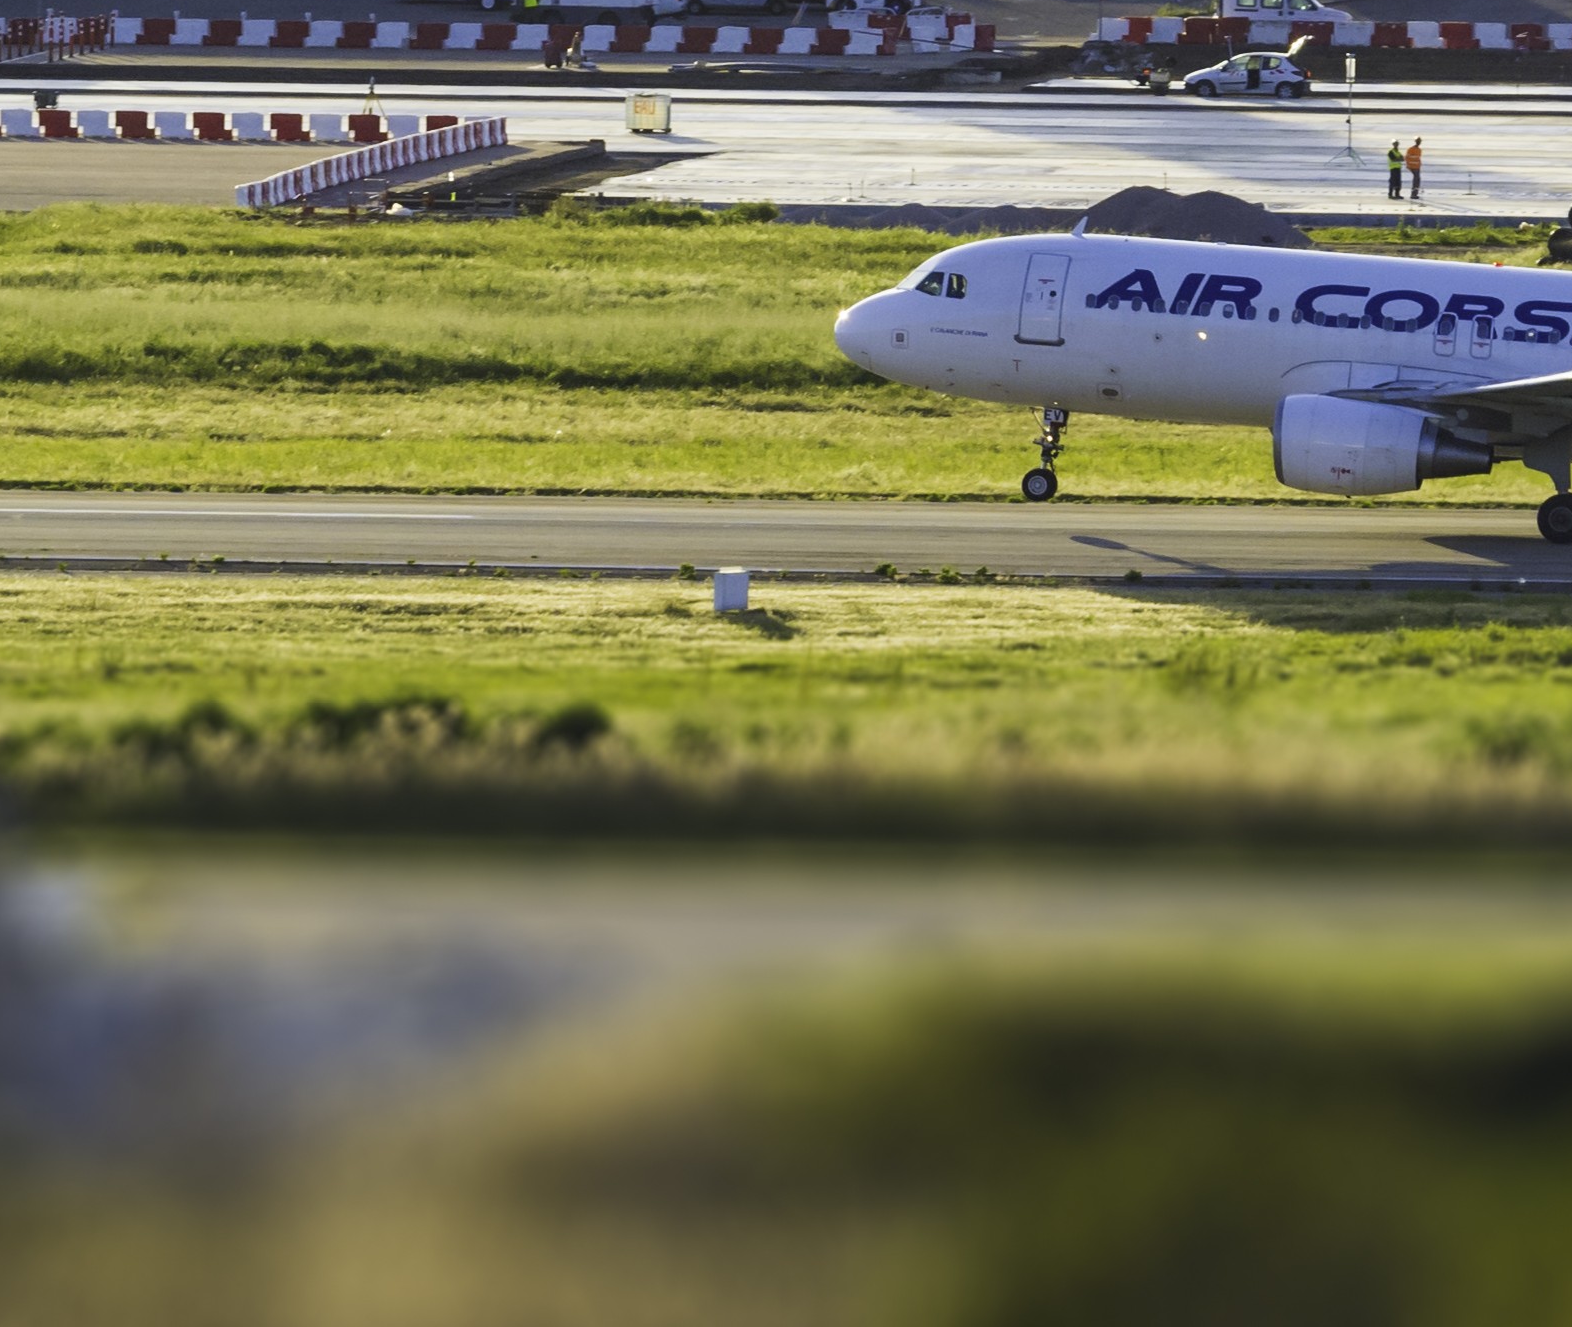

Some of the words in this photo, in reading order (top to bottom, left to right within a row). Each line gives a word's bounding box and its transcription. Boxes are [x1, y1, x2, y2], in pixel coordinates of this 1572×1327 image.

[634, 100, 656, 114] EAU
[1095, 268, 1263, 321] AIR
[1044, 409, 1062, 421] EV
